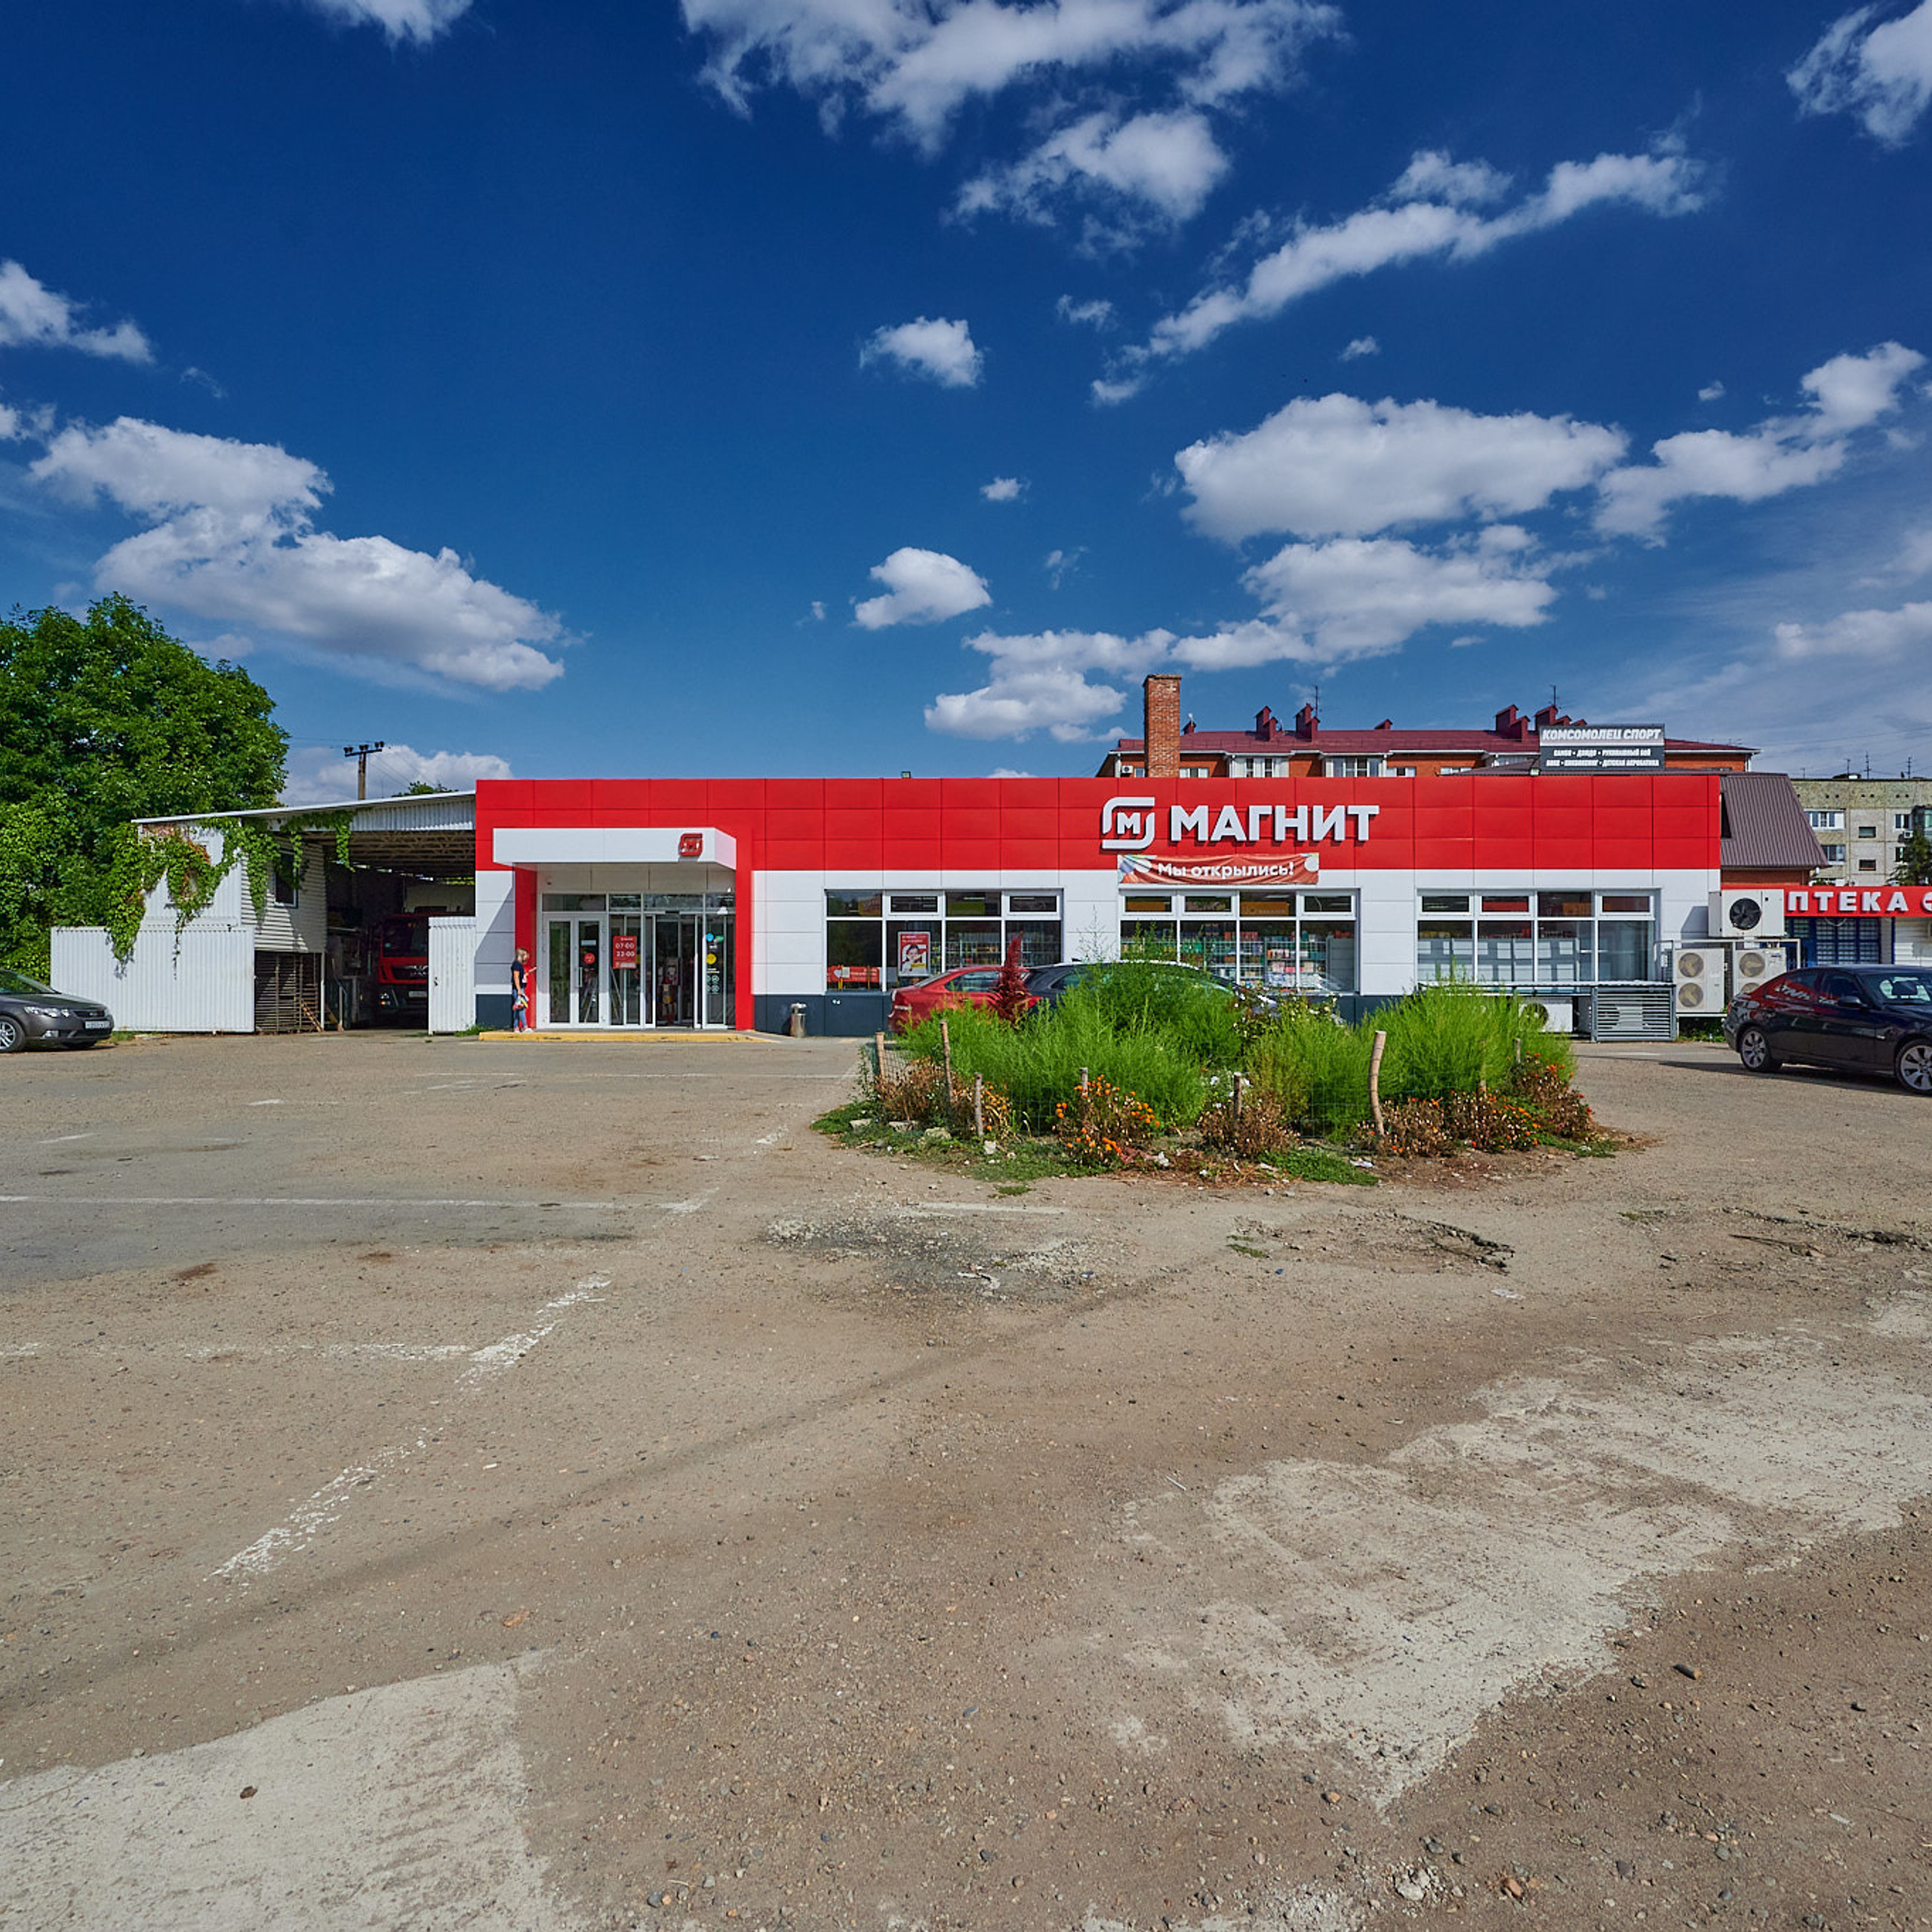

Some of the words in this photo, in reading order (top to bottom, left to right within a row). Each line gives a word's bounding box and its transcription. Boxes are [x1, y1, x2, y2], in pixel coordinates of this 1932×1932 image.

[1543, 728, 1622, 740] КОМСОМОЛЕЦ
[1623, 728, 1660, 740] СПОРТ
[1171, 805, 1380, 841] МАГНИТ
[1158, 863, 1186, 876] Мы
[1191, 862, 1294, 879] открылись!
[1787, 891, 1909, 912] ПТЕКА
